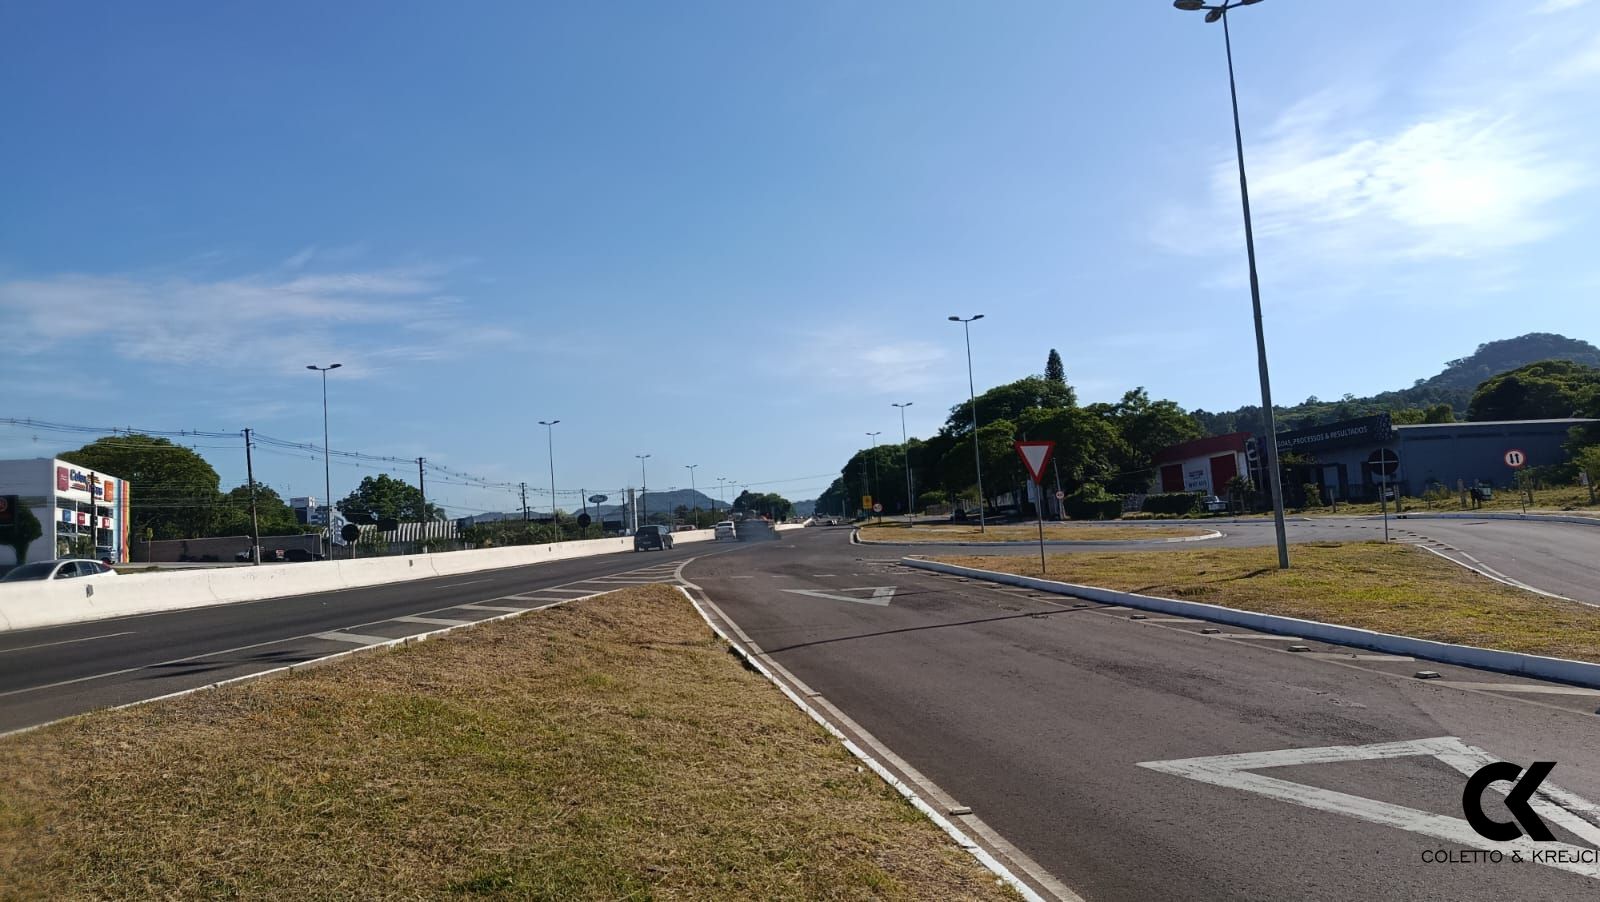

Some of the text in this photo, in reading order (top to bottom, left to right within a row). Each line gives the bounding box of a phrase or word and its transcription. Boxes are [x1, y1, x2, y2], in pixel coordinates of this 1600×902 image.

[1293, 433, 1324, 445] PROCESSOS
[1324, 432, 1330, 440] &
[1330, 426, 1368, 439] RESULTADOS
